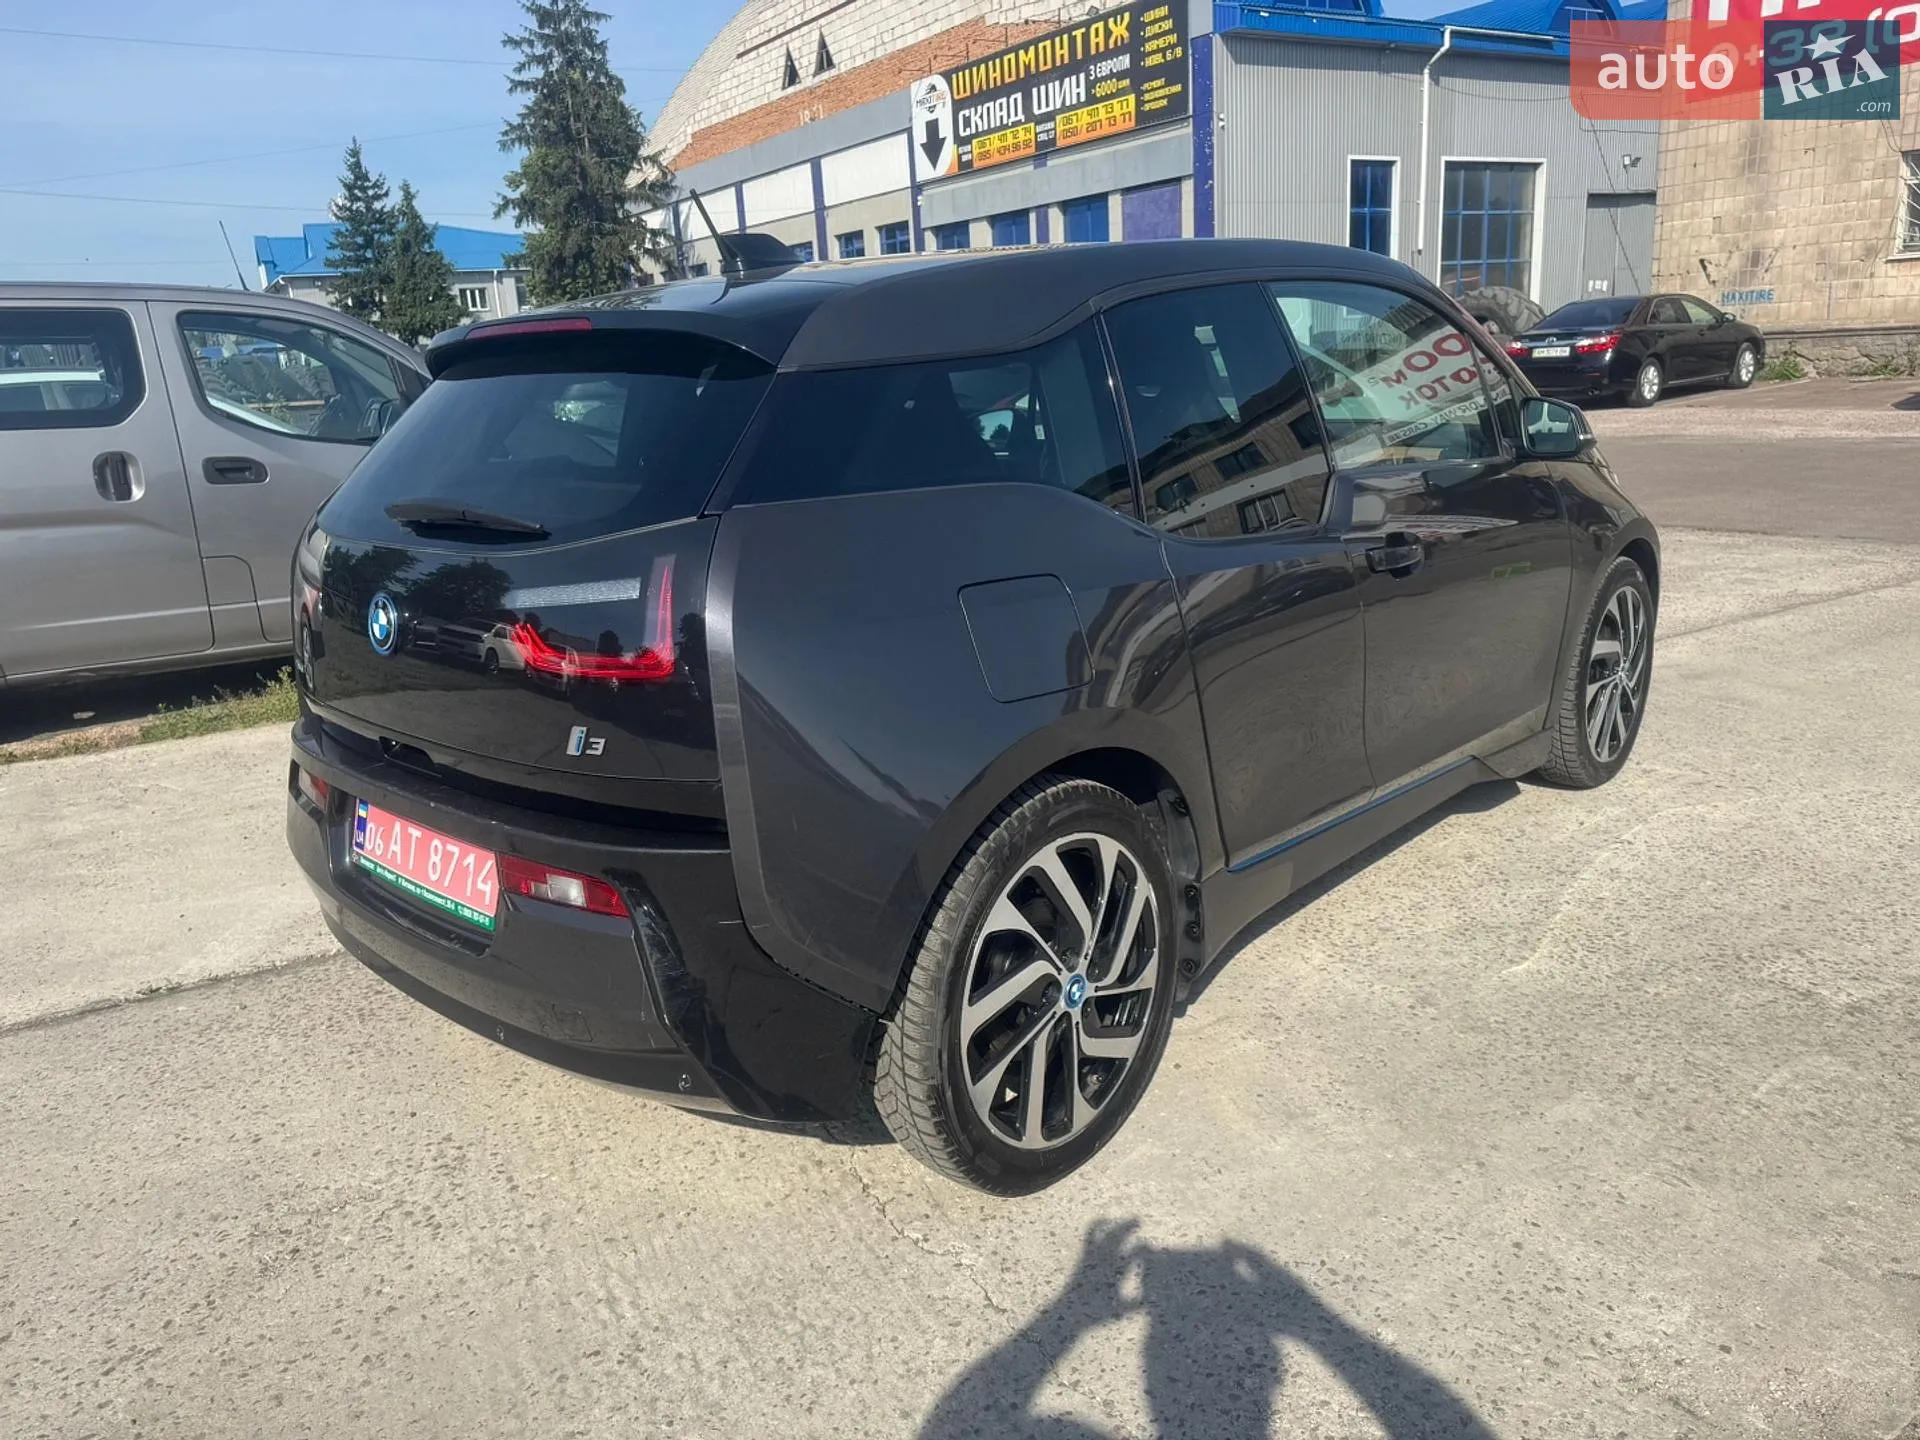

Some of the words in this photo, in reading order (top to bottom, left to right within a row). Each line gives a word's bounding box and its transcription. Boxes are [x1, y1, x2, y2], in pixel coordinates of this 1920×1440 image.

[952, 12, 1131, 100] ШИНОМОНТАЖ
[1096, 53, 1131, 78] ЄВРОПИ
[959, 93, 1026, 137] СКЛАД
[1032, 73, 1087, 117] ШИН
[1102, 102, 1114, 114] 73
[1117, 98, 1130, 110] 77
[1105, 115, 1117, 127] 73
[1120, 111, 1132, 123] 77
[566, 726, 606, 756] i3
[365, 822, 385, 856] 06
[387, 821, 423, 870] AT
[428, 838, 495, 906] 8714
